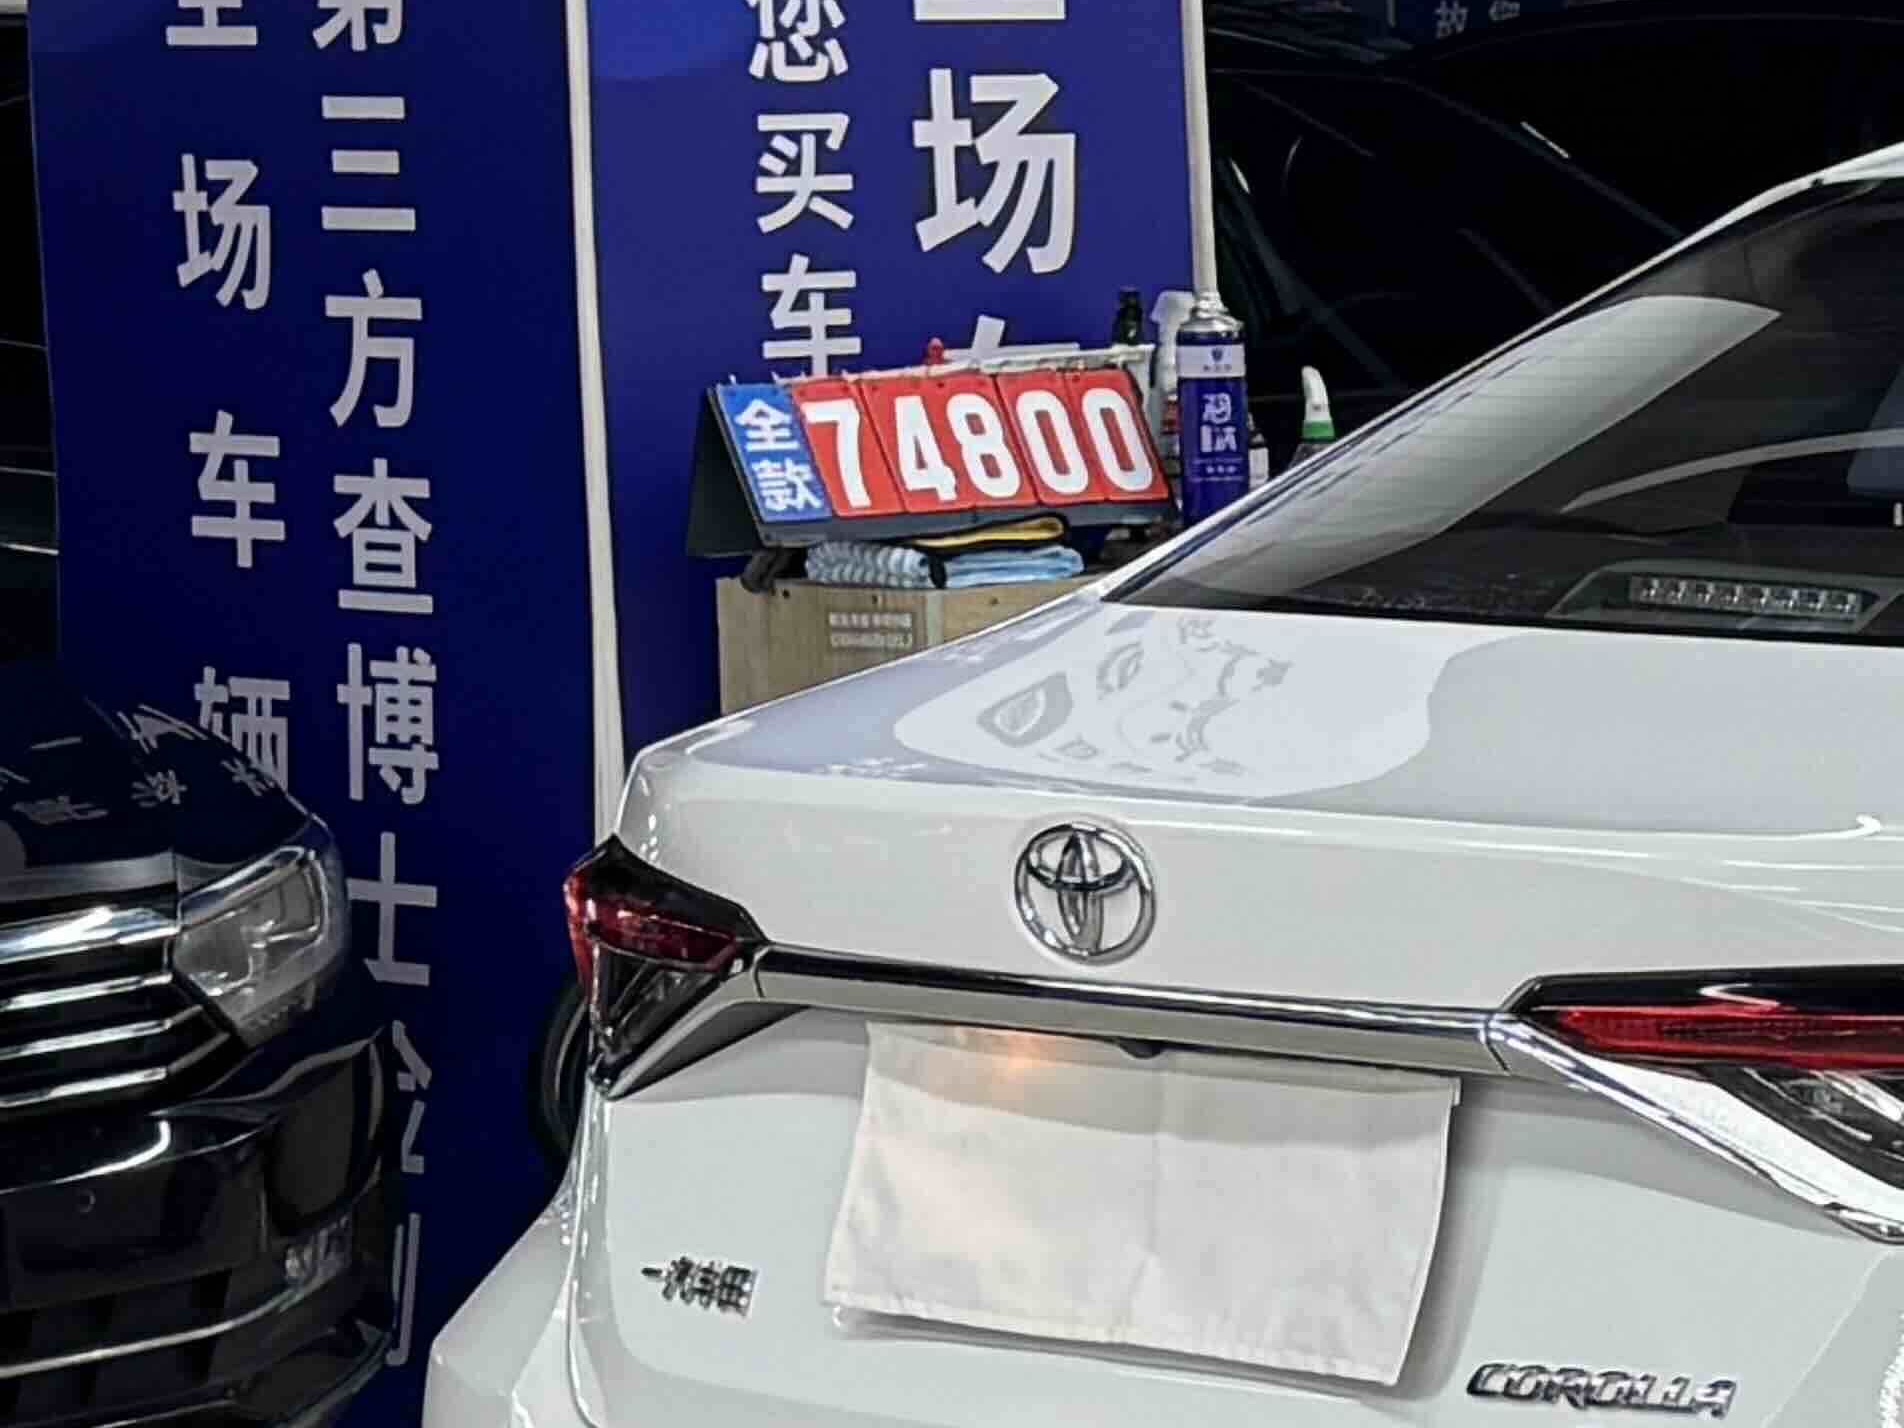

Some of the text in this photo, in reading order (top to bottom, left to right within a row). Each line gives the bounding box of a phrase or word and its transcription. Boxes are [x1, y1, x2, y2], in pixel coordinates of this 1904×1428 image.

[733, 396, 829, 514] 全款
[800, 384, 1155, 512] 74800
[1466, 1362, 1737, 1419] COROLLA
